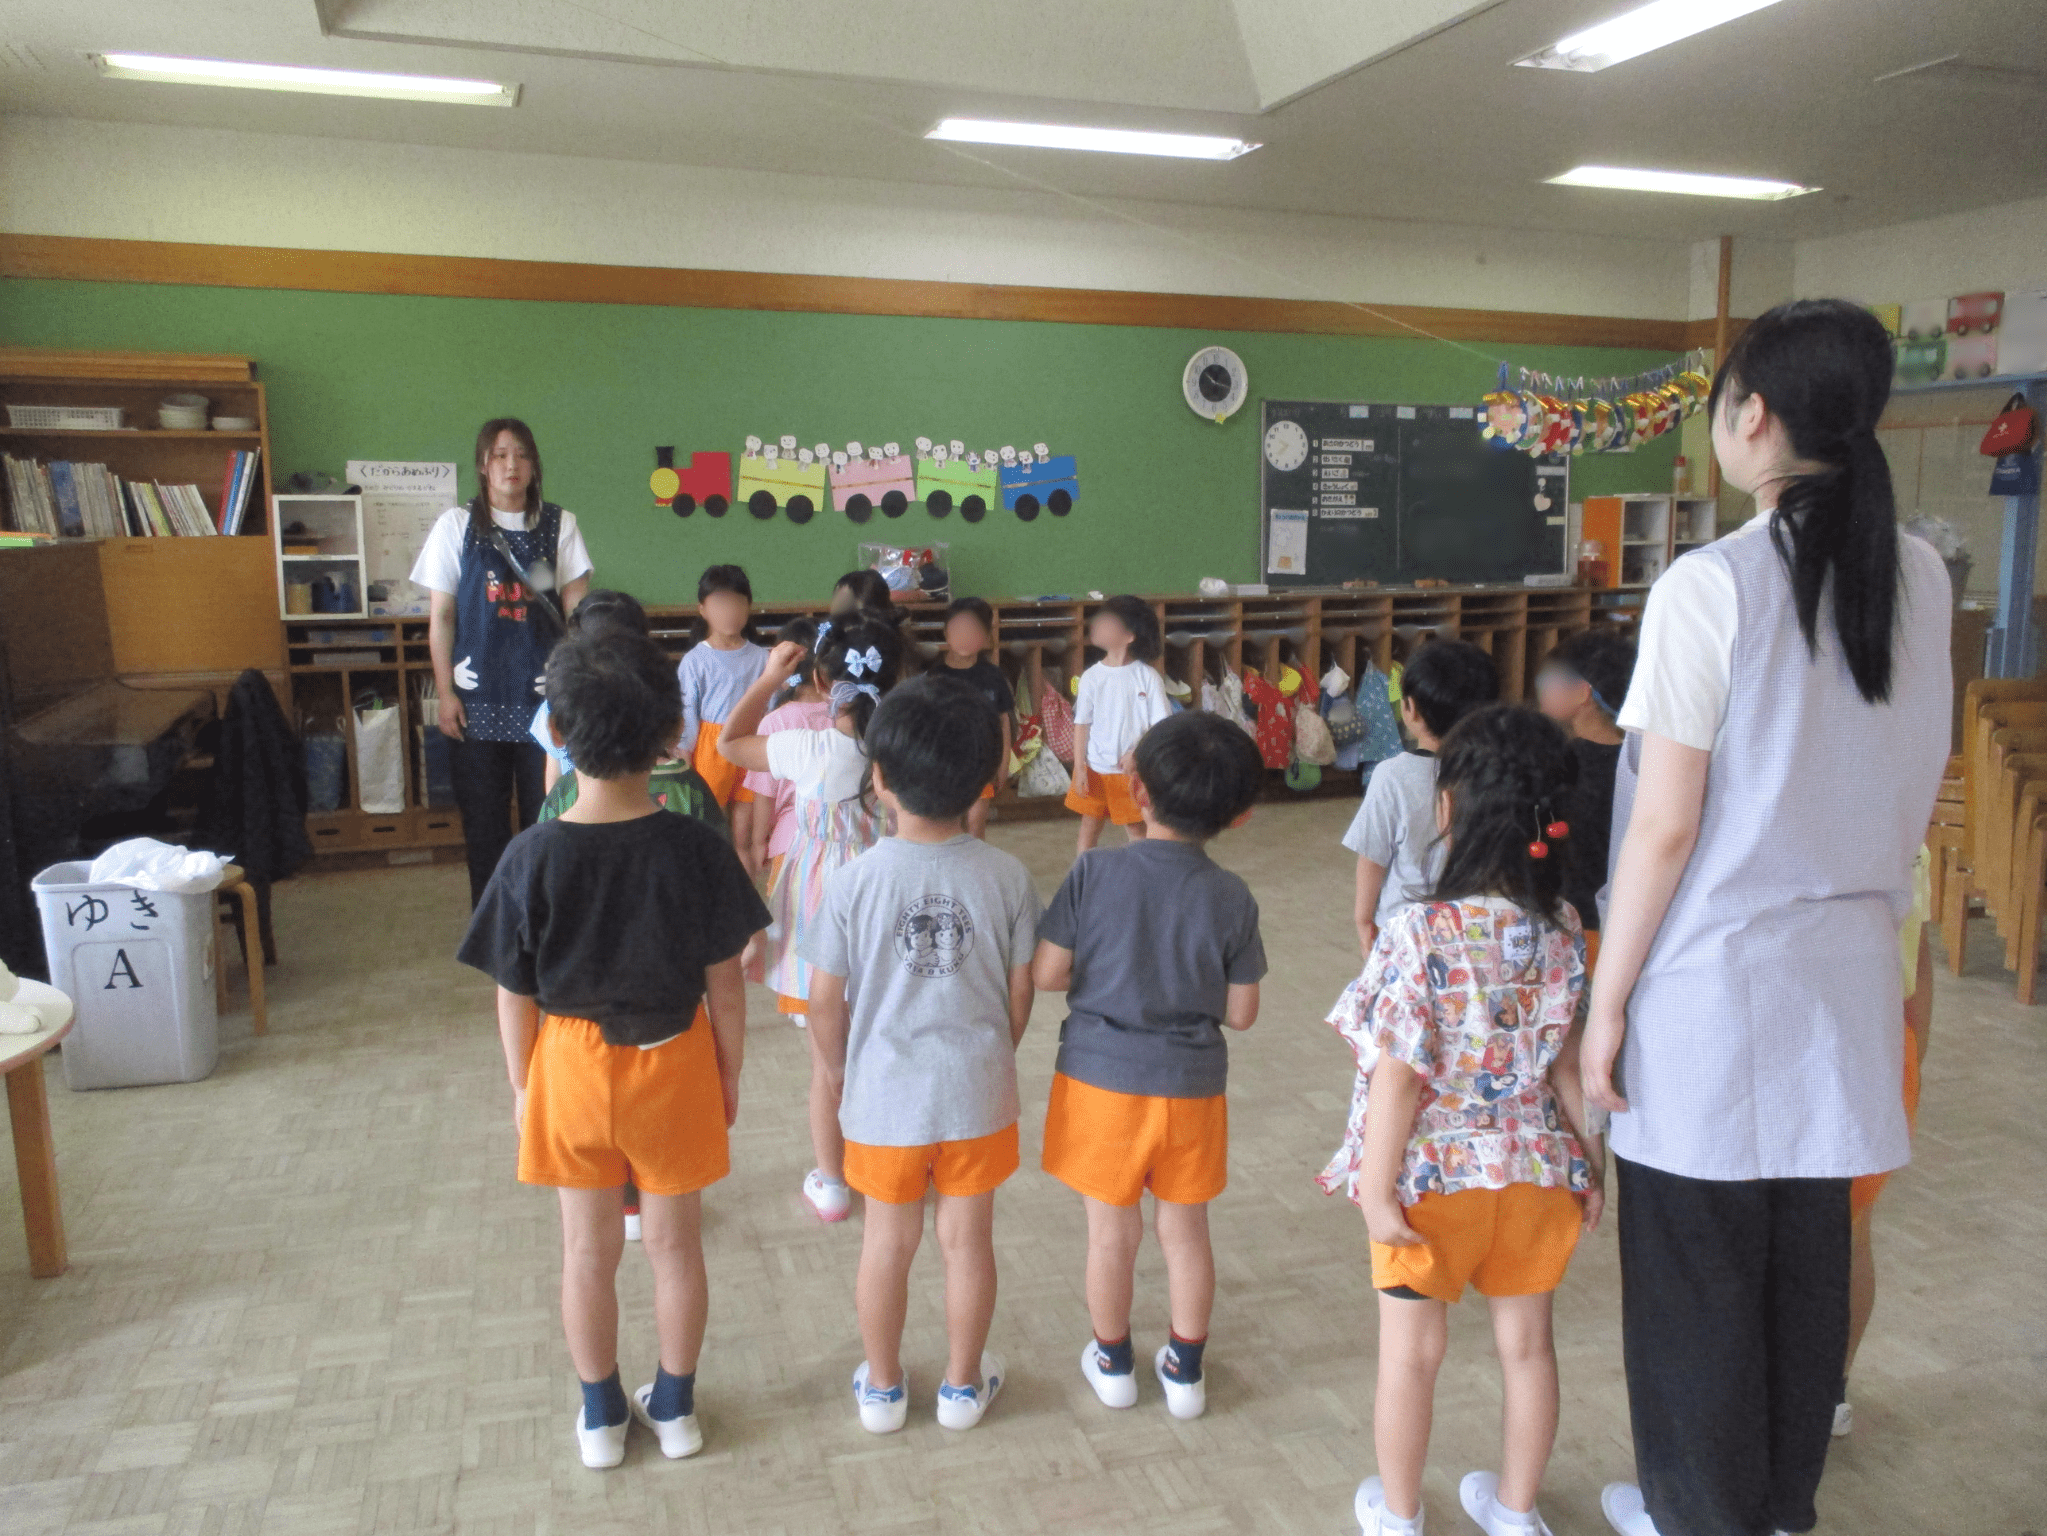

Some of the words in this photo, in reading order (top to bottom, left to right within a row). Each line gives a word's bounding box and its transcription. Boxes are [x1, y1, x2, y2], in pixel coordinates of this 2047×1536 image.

[66, 889, 159, 932] ゆき
[896, 903, 920, 937] EIGHTY
[924, 897, 958, 909] EIGHT
[104, 948, 144, 989] A
